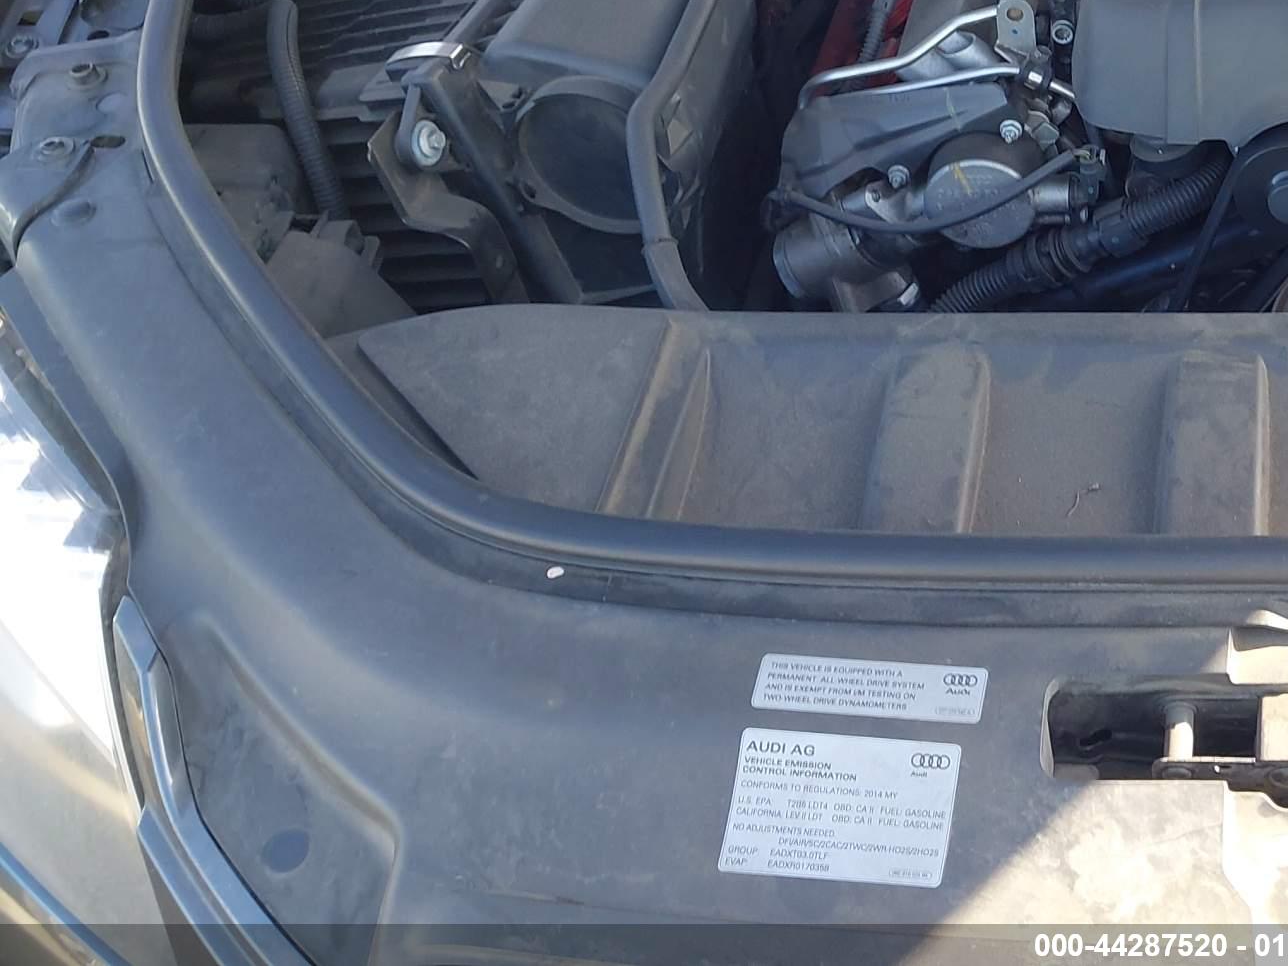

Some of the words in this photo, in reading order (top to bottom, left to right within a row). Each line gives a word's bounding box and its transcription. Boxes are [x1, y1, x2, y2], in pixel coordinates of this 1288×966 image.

[771, 661, 789, 670] THIS
[790, 662, 821, 672] VEHICLE
[833, 665, 873, 676] EQUIPPED
[874, 668, 895, 677] WITH
[767, 672, 817, 683] PERMANENT
[821, 675, 835, 684] ALL
[838, 676, 865, 686] WHEEL
[866, 679, 889, 688] DRIVE
[892, 681, 925, 690] SYSTEM
[765, 682, 783, 690] AND
[794, 684, 826, 694] EXEMPT
[829, 686, 852, 696] FROM
[867, 689, 901, 699] TESTING
[903, 691, 916, 700] ON
[945, 687, 971, 696] Audi
[813, 696, 836, 706] DRIVE
[838, 698, 907, 711] DYNAMOMETERS
[746, 740, 786, 754] AUDI
[790, 744, 815, 756] AG
[744, 755, 783, 766] VEHICLE
[785, 759, 832, 770] EMISSION
[742, 765, 786, 776] CONTROL
[789, 768, 857, 782] INFORMATION
[910, 770, 928, 778] Audi
[741, 780, 788, 792] CONFORMS
[791, 783, 801, 792] TO
[864, 789, 883, 798] 2014
[885, 791, 898, 799] MY
[856, 804, 867, 814] CA
[904, 807, 946, 819] GASOLINE
[732, 822, 745, 831] NO
[746, 823, 802, 835] ADJUSTMENTS
[854, 815, 865, 825] CA
[903, 819, 944, 831] GASOLINE
